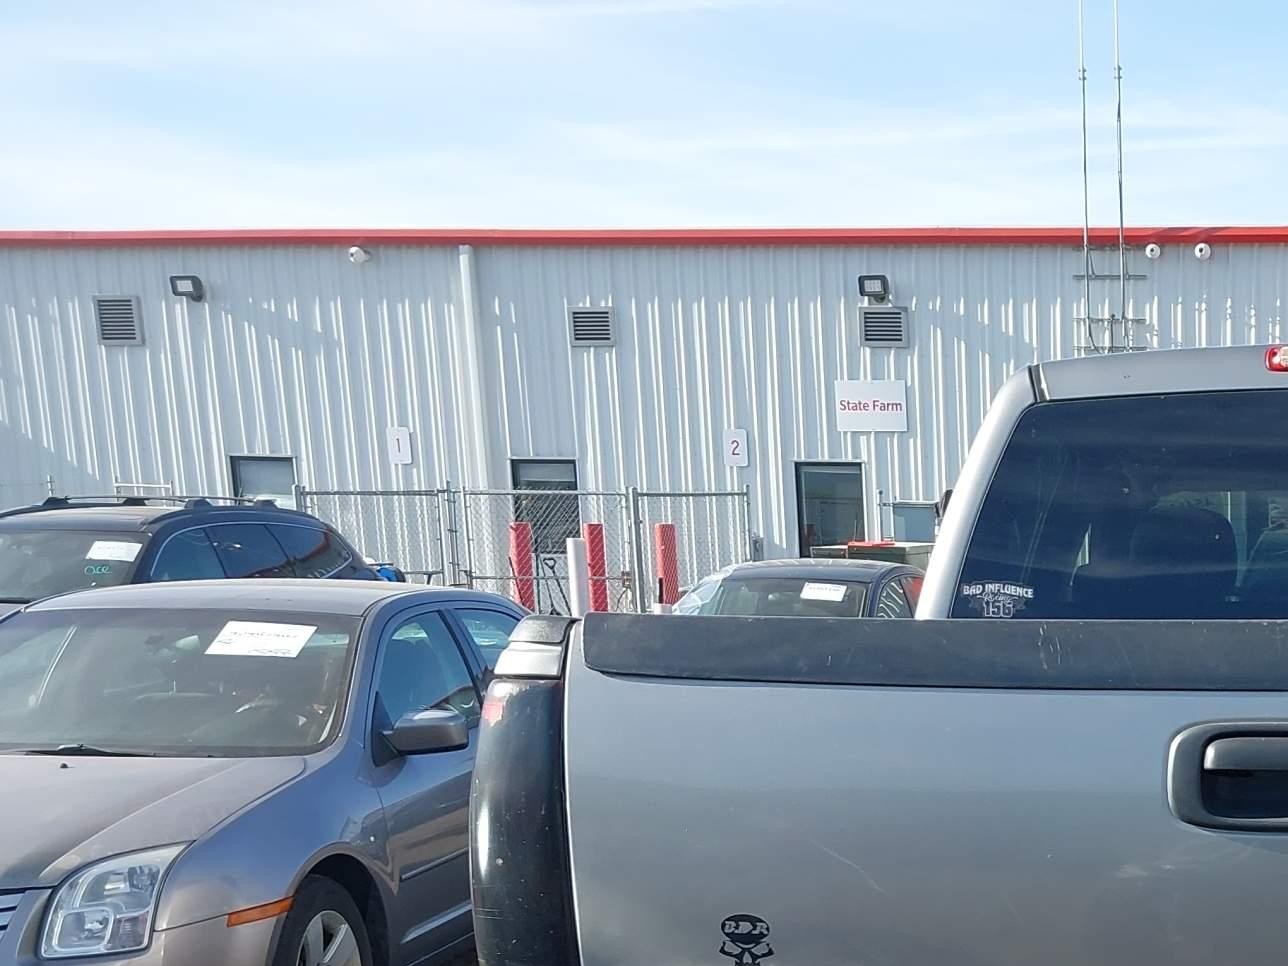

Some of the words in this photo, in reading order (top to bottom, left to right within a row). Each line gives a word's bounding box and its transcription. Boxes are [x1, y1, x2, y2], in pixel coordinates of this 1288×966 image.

[839, 400, 870, 412] State
[872, 400, 903, 412] Farm
[730, 439, 741, 456] 2
[963, 584, 983, 596] BAD
[985, 583, 1035, 599] INFLUENCE
